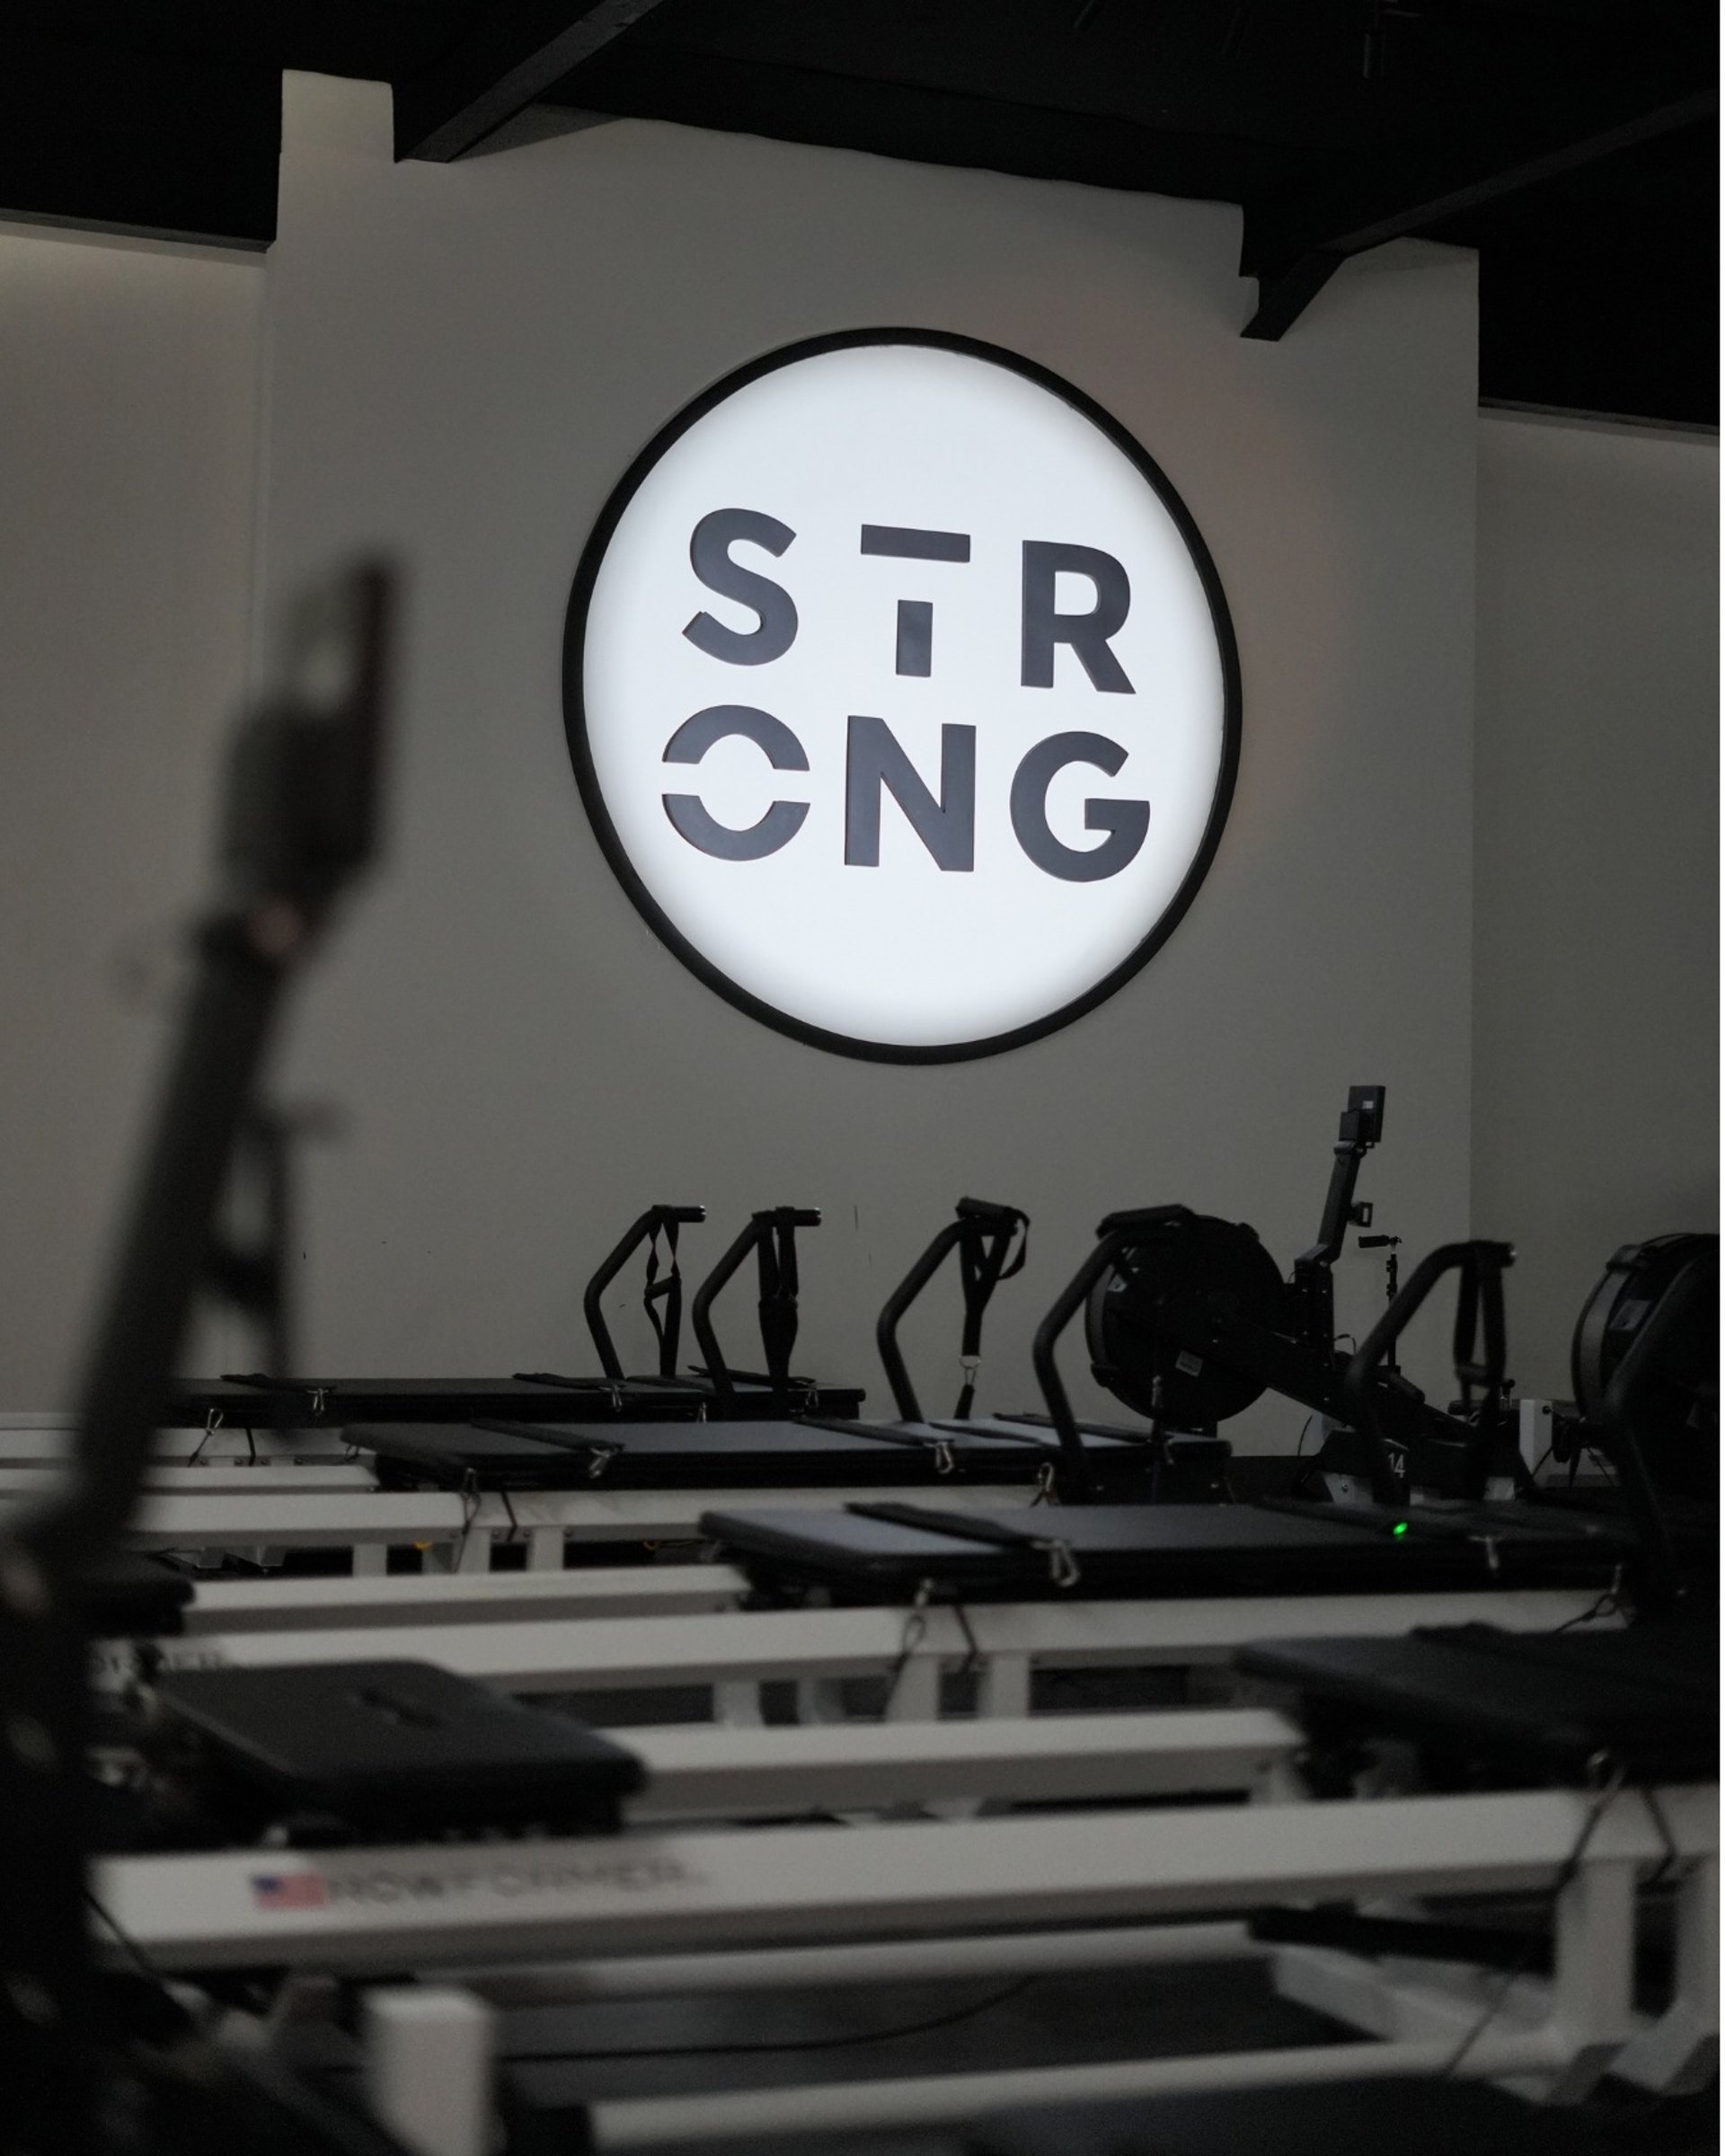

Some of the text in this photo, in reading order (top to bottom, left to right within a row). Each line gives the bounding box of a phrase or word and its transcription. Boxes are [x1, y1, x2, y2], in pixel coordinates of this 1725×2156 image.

[682, 508, 1136, 694] STR
[662, 705, 1150, 882] ONG
[1388, 1452, 1406, 1479] 14
